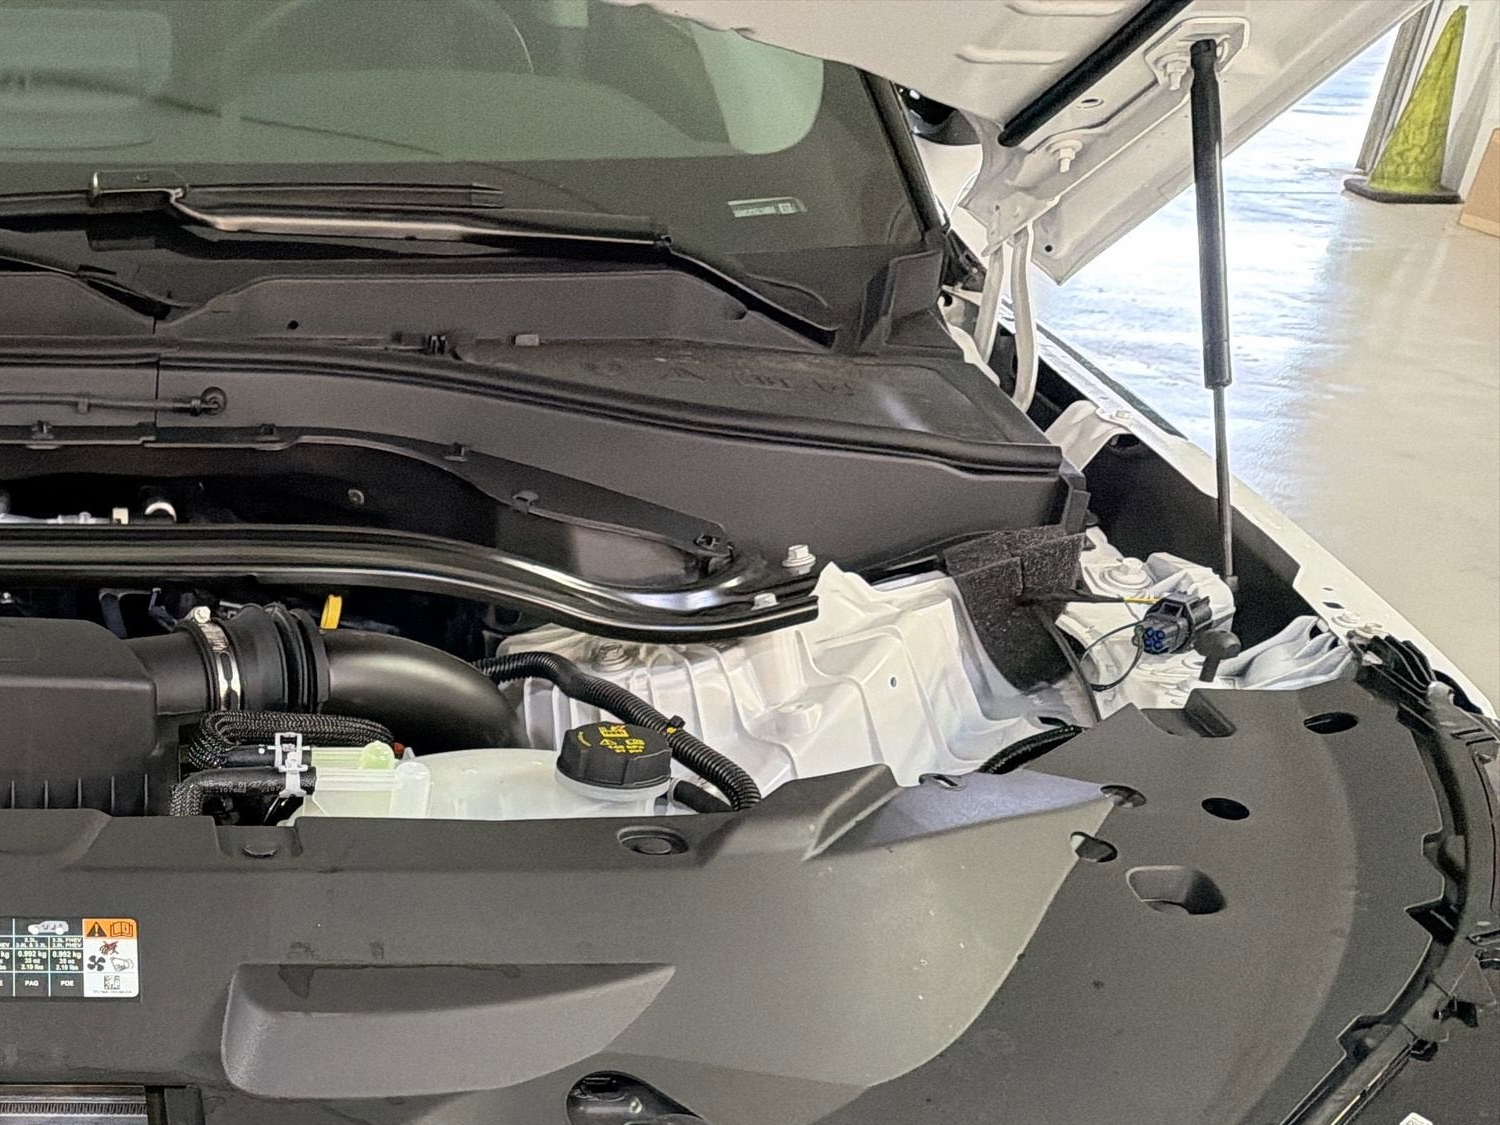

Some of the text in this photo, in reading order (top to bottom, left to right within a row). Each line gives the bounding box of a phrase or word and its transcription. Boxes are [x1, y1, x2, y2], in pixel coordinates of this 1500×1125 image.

[0, 950, 10, 959] kg
[38, 950, 47, 959] kg
[72, 950, 82, 959] kg
